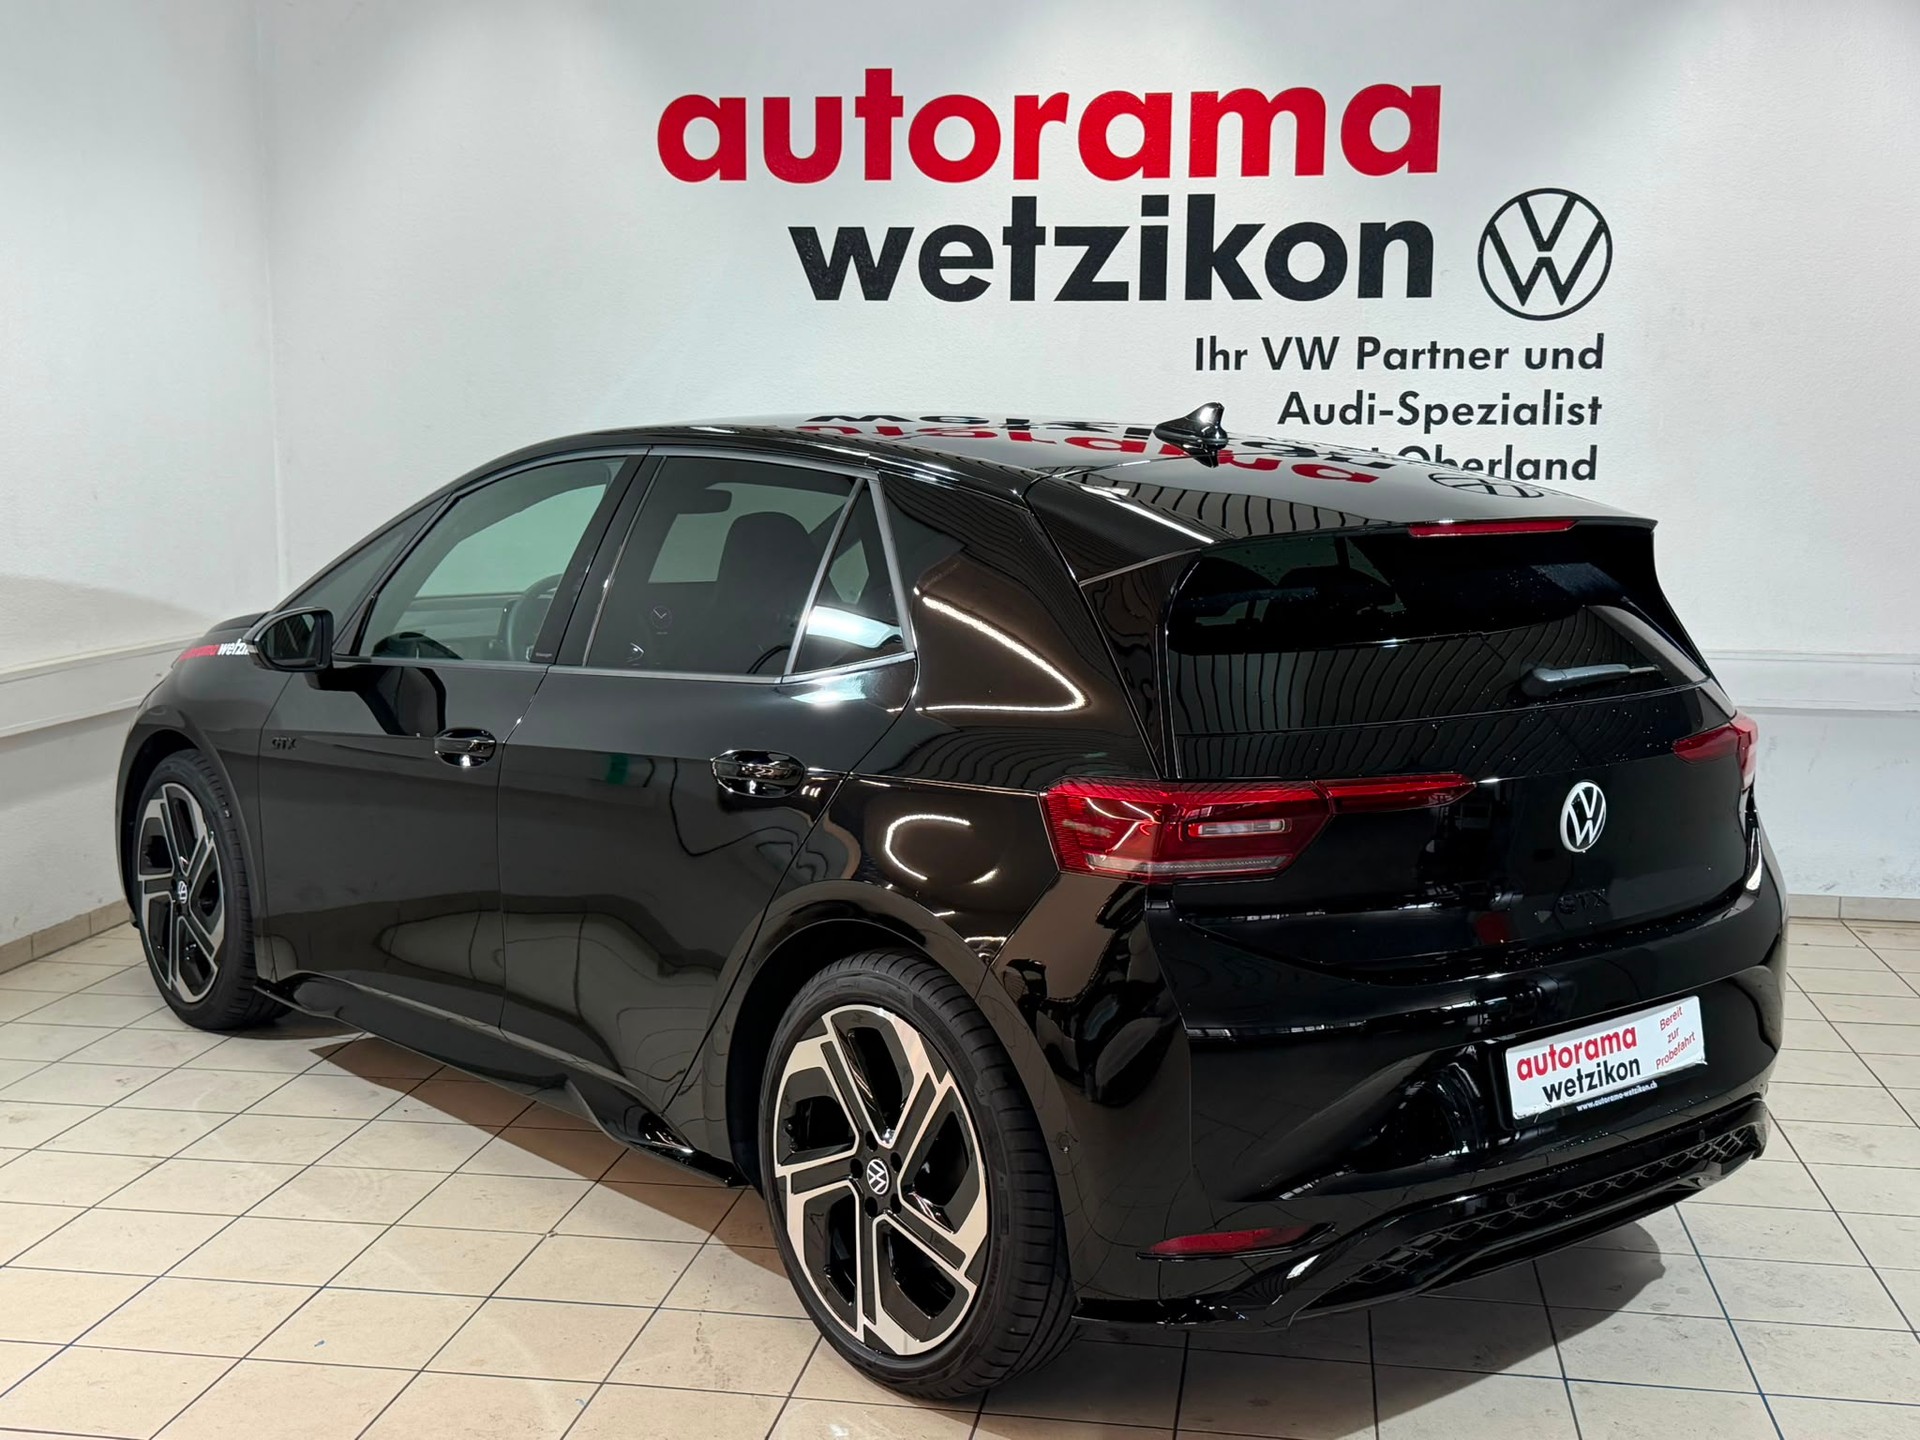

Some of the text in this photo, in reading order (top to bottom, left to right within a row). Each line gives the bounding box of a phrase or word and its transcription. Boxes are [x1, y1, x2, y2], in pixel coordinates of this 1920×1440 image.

[657, 68, 1441, 184] autorama
[788, 193, 1434, 303] wetzikon
[1195, 333, 1605, 371] Ihr VW Partner und
[1277, 389, 1602, 435] Audi-Spezialist
[1659, 1005, 1684, 1032] Bereit
[1667, 1026, 1681, 1044] zur
[1516, 1026, 1638, 1081] autorama
[1655, 1031, 1697, 1071] Probefahrt
[1541, 1057, 1642, 1103] wetzikon
